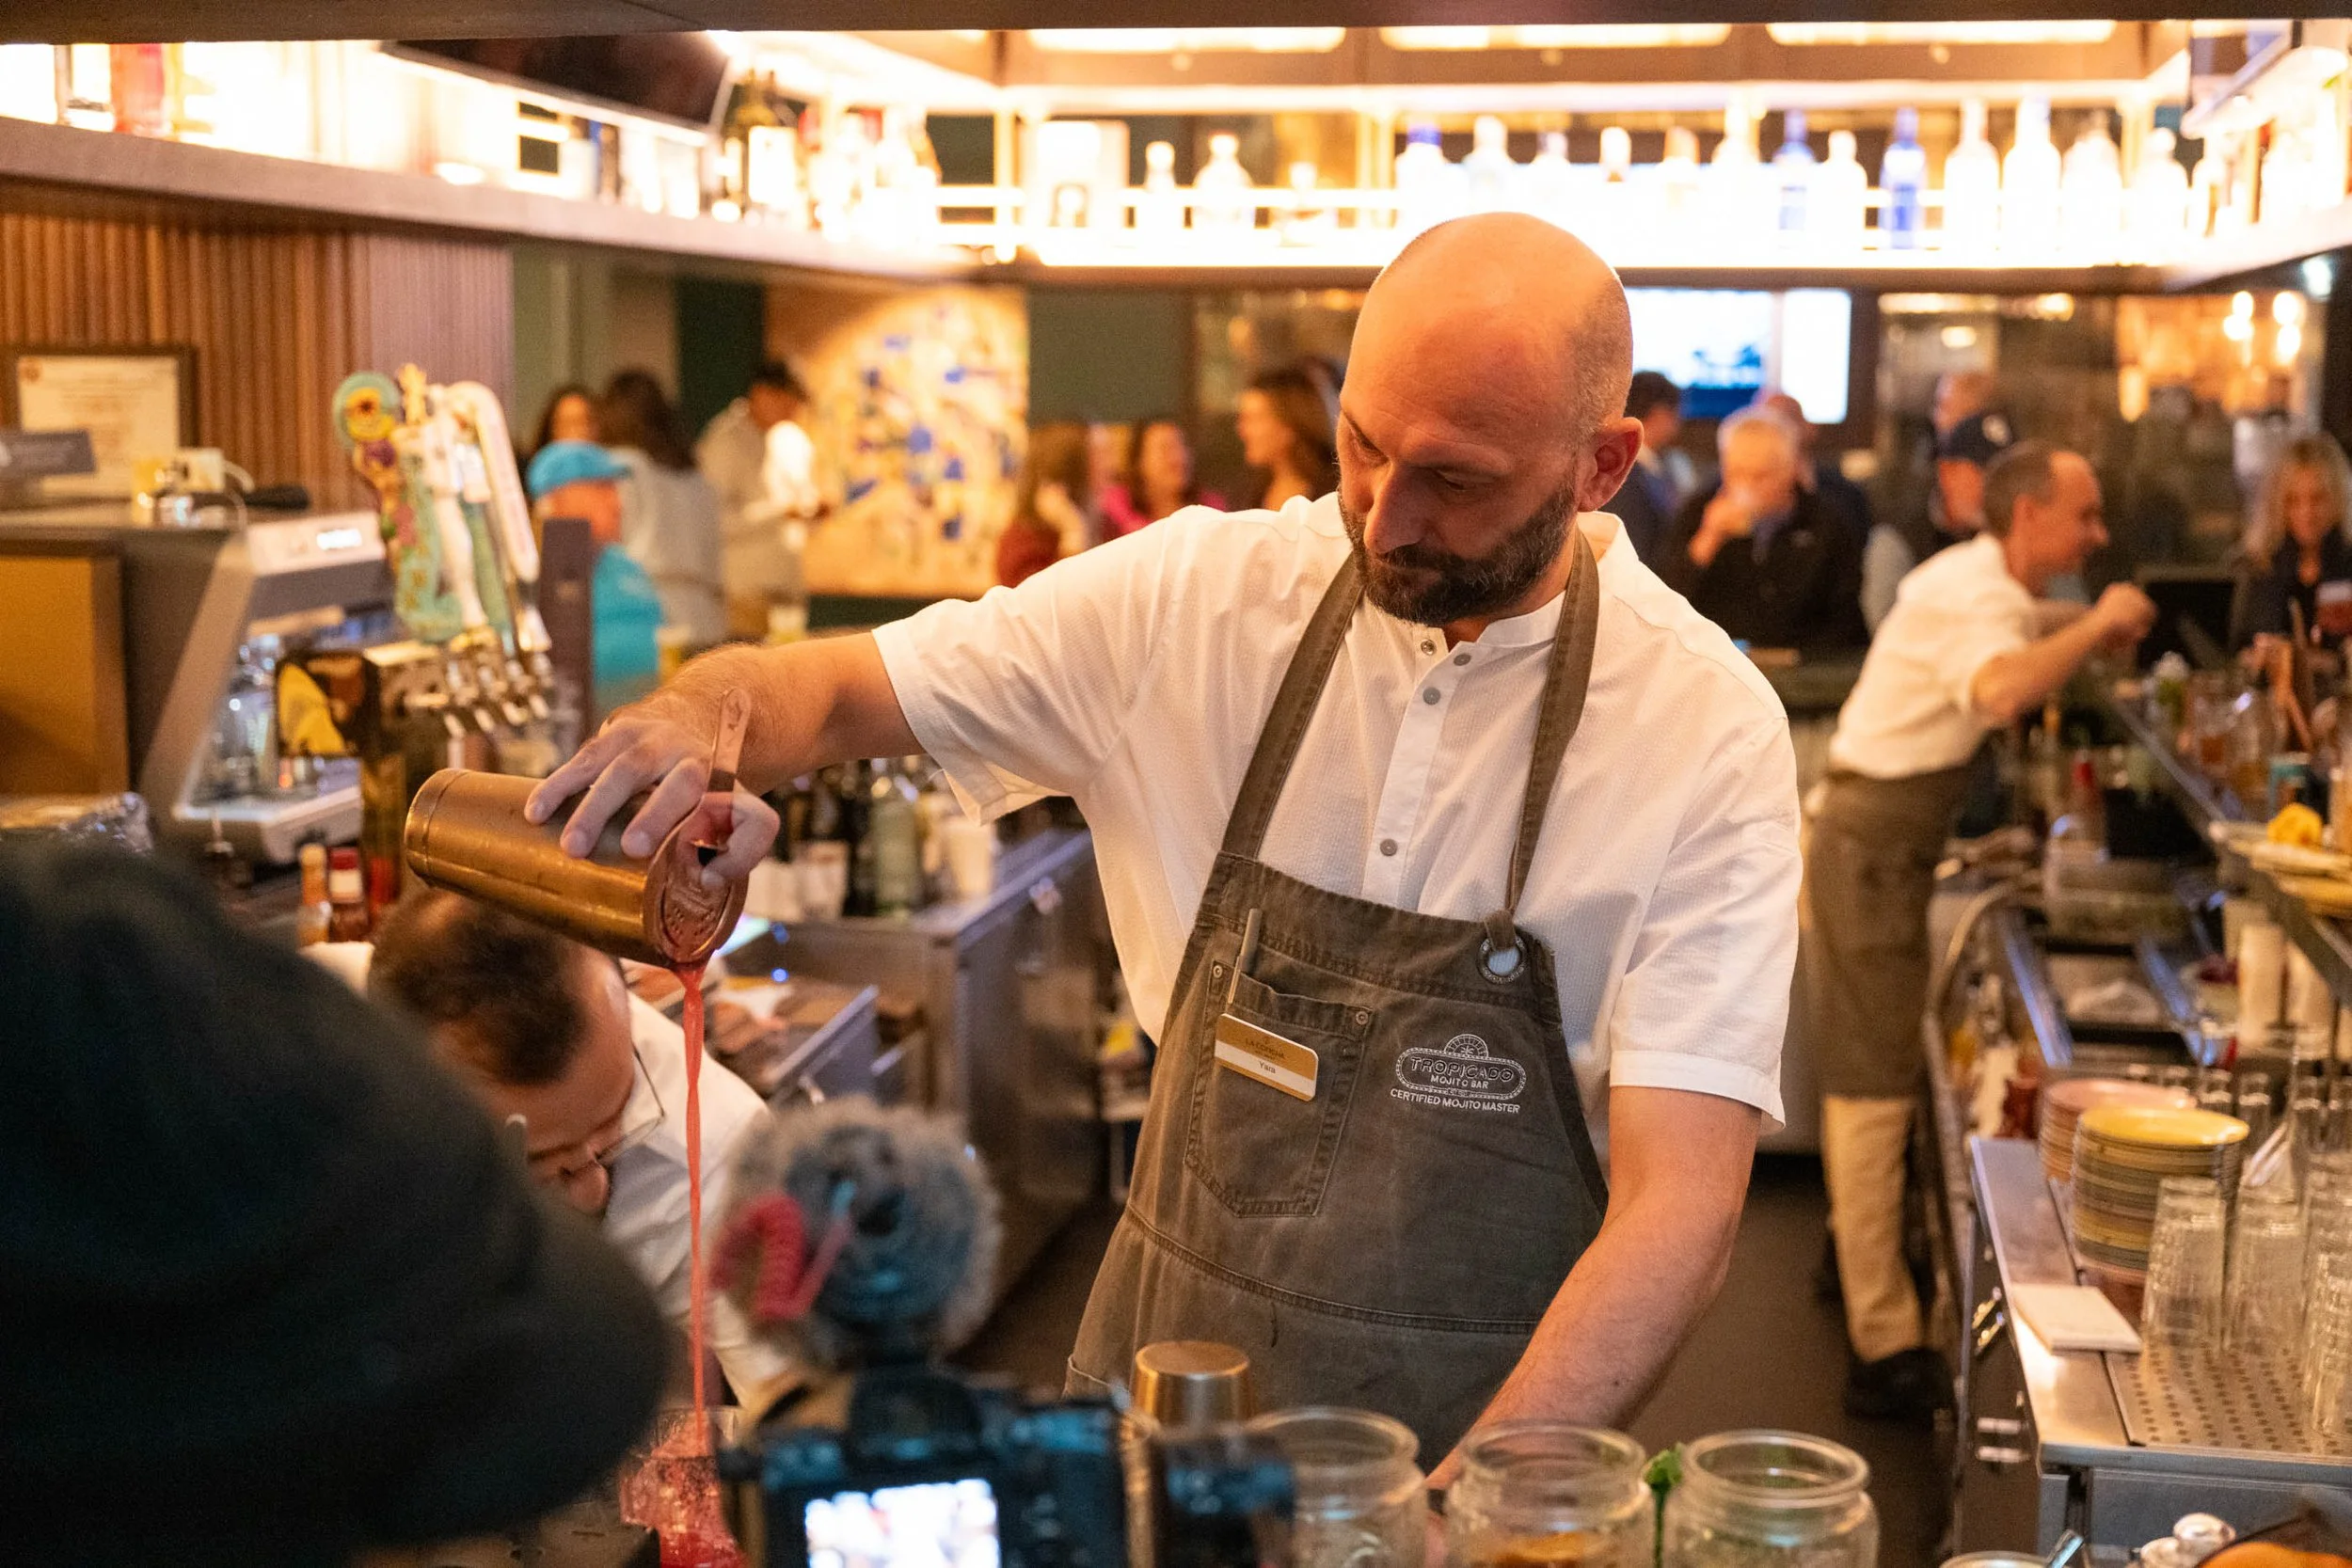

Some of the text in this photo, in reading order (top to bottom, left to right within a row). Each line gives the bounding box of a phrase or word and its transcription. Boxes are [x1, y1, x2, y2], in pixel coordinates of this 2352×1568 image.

[1259, 1061, 1276, 1074] Yara
[1410, 1057, 1514, 1082] TROPICADO
[1430, 1074, 1489, 1089] MOJITO BAR
[1390, 1087, 1440, 1105] CERTIFIED
[1442, 1097, 1481, 1110] MOJITO
[1482, 1101, 1521, 1114] MASTER
